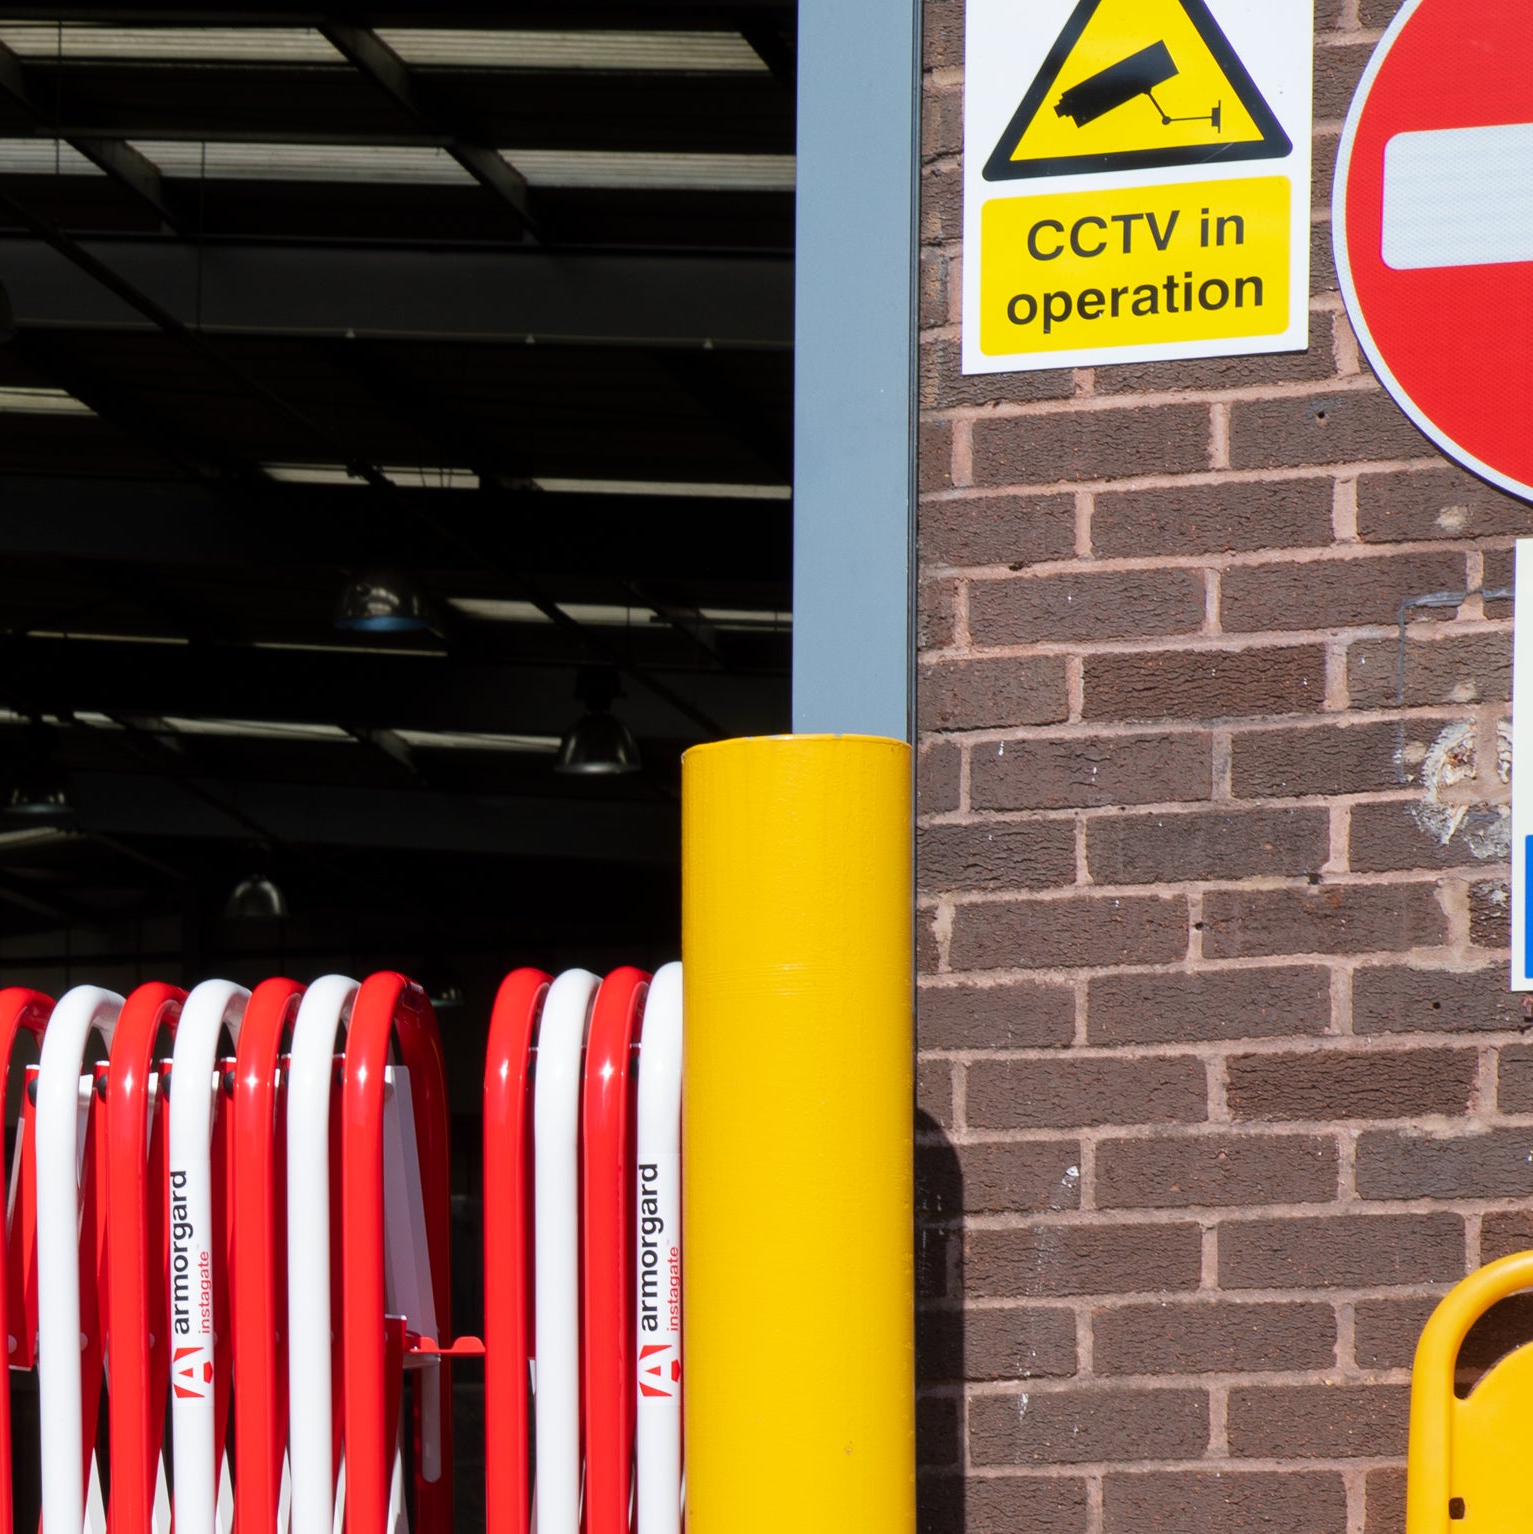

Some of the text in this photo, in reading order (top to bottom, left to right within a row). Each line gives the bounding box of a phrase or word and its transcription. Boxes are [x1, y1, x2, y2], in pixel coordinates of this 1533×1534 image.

[1027, 207, 1245, 261] CCTV in
[1006, 270, 1264, 335] operation
[170, 1170, 194, 1335] armorgard
[638, 1163, 664, 1332] armorgard
[666, 1246, 681, 1332] instagate
[198, 1250, 212, 1334] instagate
